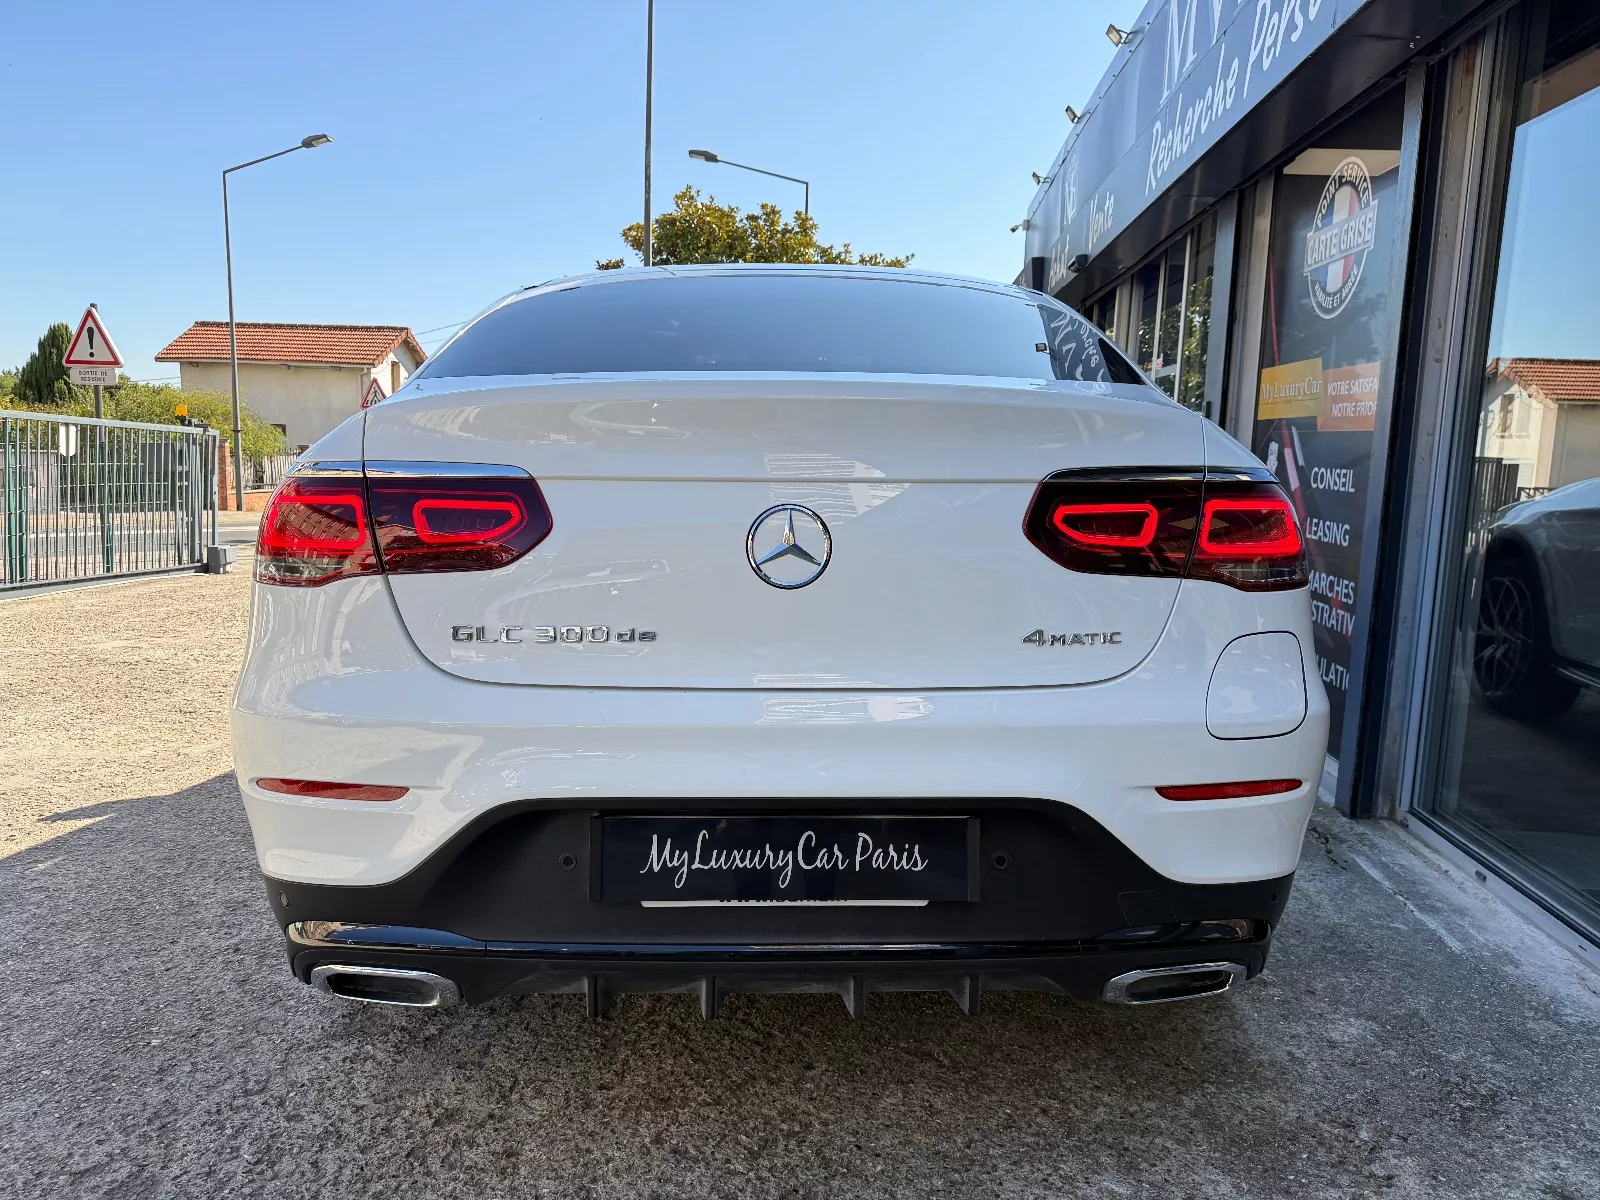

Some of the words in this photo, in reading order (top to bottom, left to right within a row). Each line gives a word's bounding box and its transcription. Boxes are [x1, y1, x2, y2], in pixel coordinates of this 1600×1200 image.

[1089, 191, 1114, 252] Vente
[1146, 43, 1239, 196] Recherche
[1317, 171, 1341, 228] POINT
[1341, 163, 1369, 209] SERVICE
[1307, 227, 1338, 266] CARTE
[1340, 210, 1374, 252] GRISE
[1261, 376, 1322, 402] MyLuxuryCar
[1328, 380, 1349, 396] VOTRE
[1331, 402, 1355, 418] NOTRE
[1310, 466, 1355, 493] CONSEIL
[1306, 516, 1350, 547] LEASING
[1311, 599, 1356, 637] STRATIV
[450, 624, 523, 643] GLC
[1021, 628, 1122, 646] 4MATIC
[640, 829, 850, 889] MyLuxuryCar
[855, 831, 928, 872] Paris
